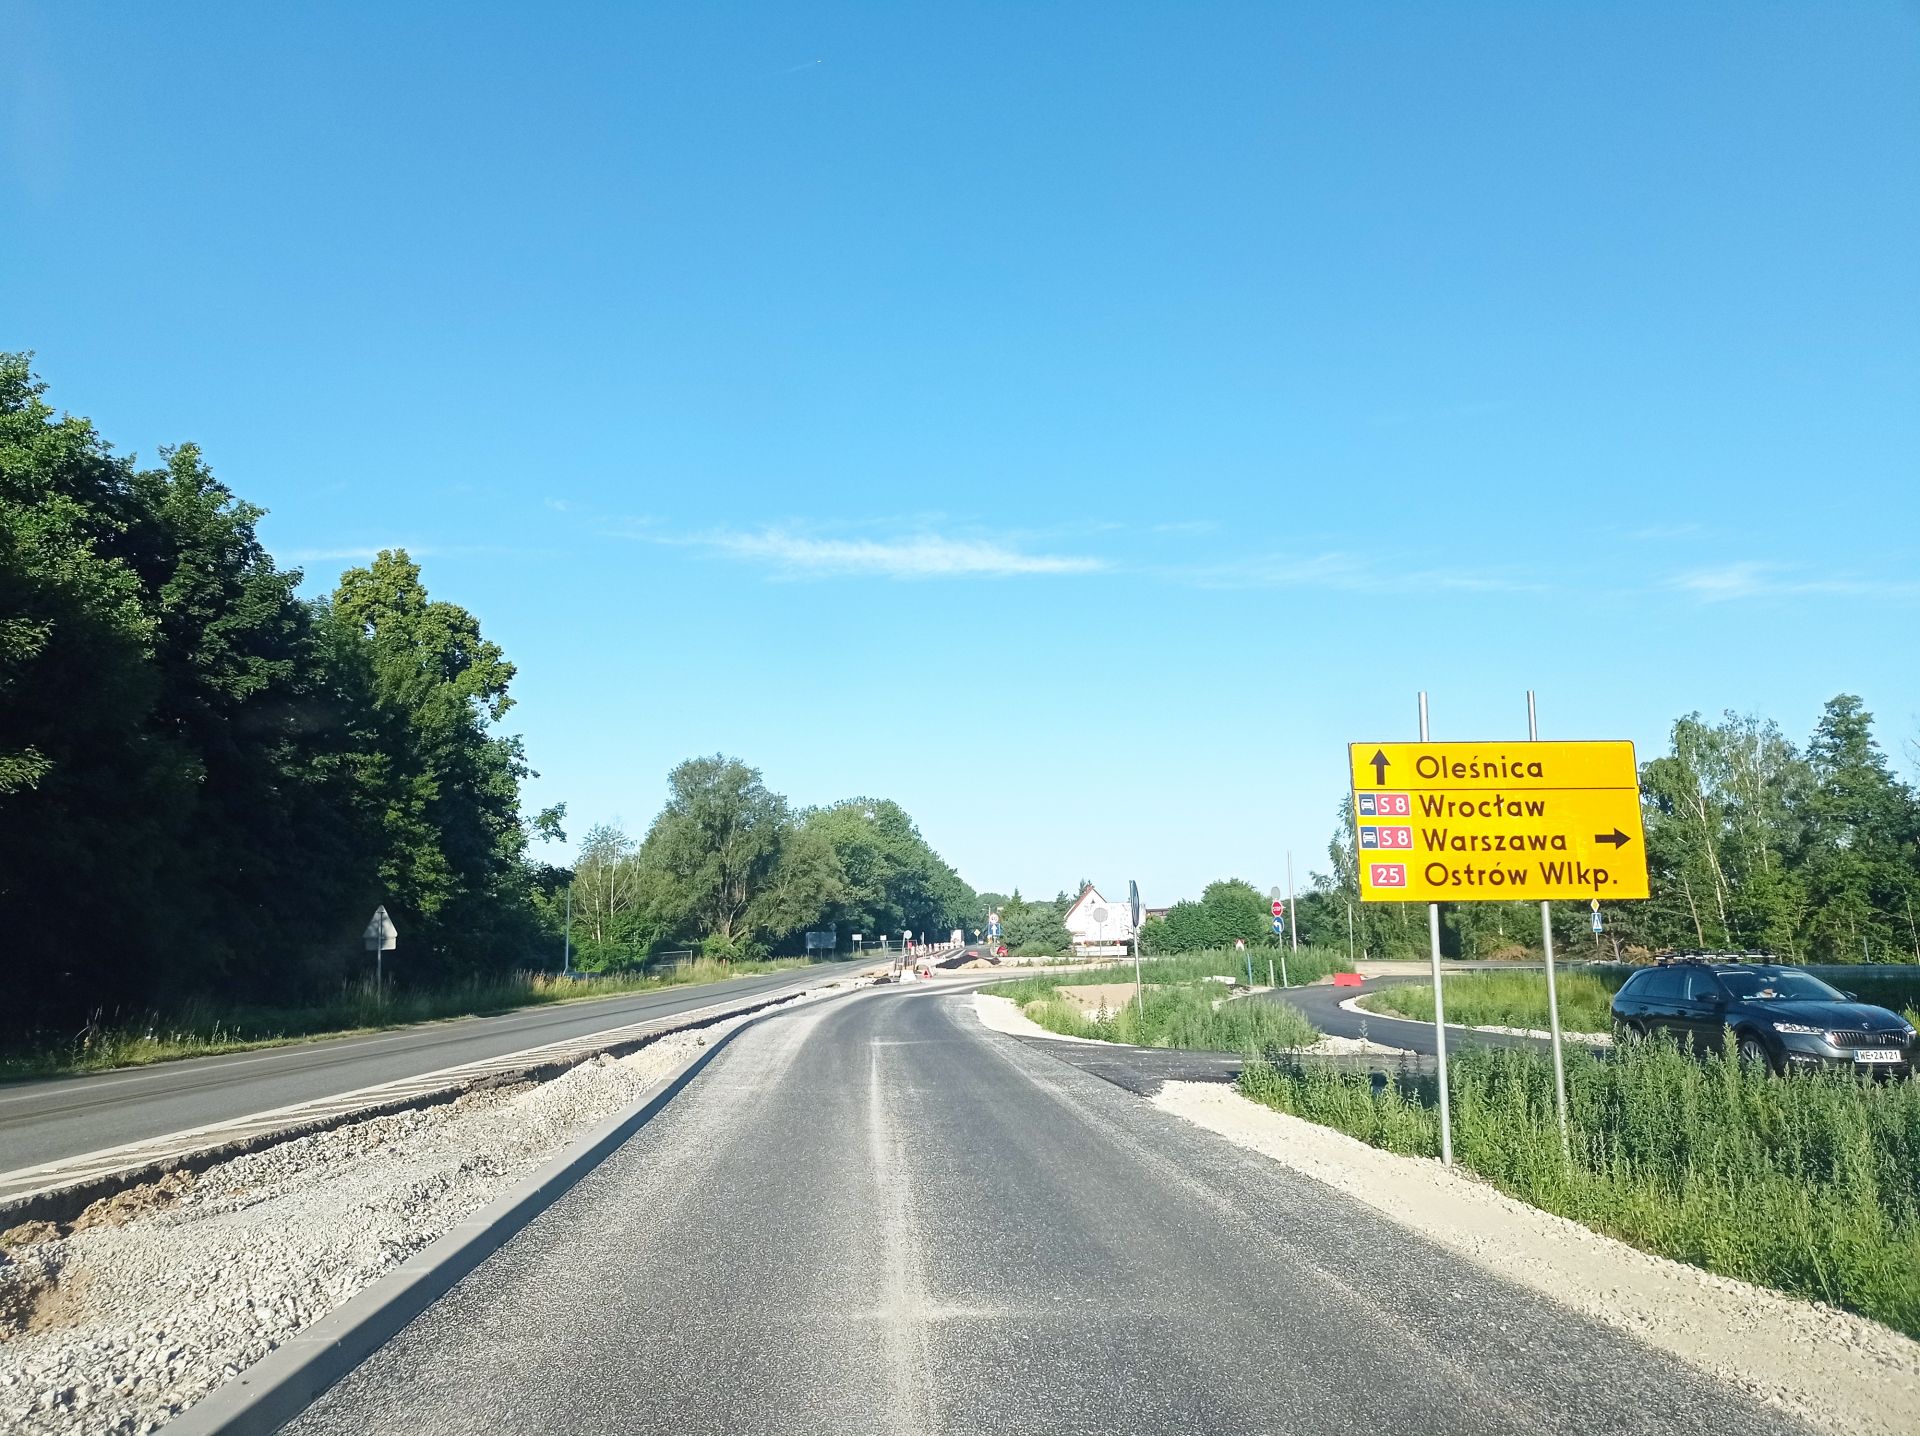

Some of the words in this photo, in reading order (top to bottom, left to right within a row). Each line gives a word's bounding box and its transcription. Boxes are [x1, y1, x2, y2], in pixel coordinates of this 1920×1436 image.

[1415, 755, 1544, 780] Oleśnica
[1419, 794, 1545, 818] Wrocław
[1421, 828, 1567, 851] Warszawa
[1377, 867, 1400, 883] 25
[1424, 862, 1528, 887] Ostrów
[1539, 861, 1618, 892] Wlkp.
